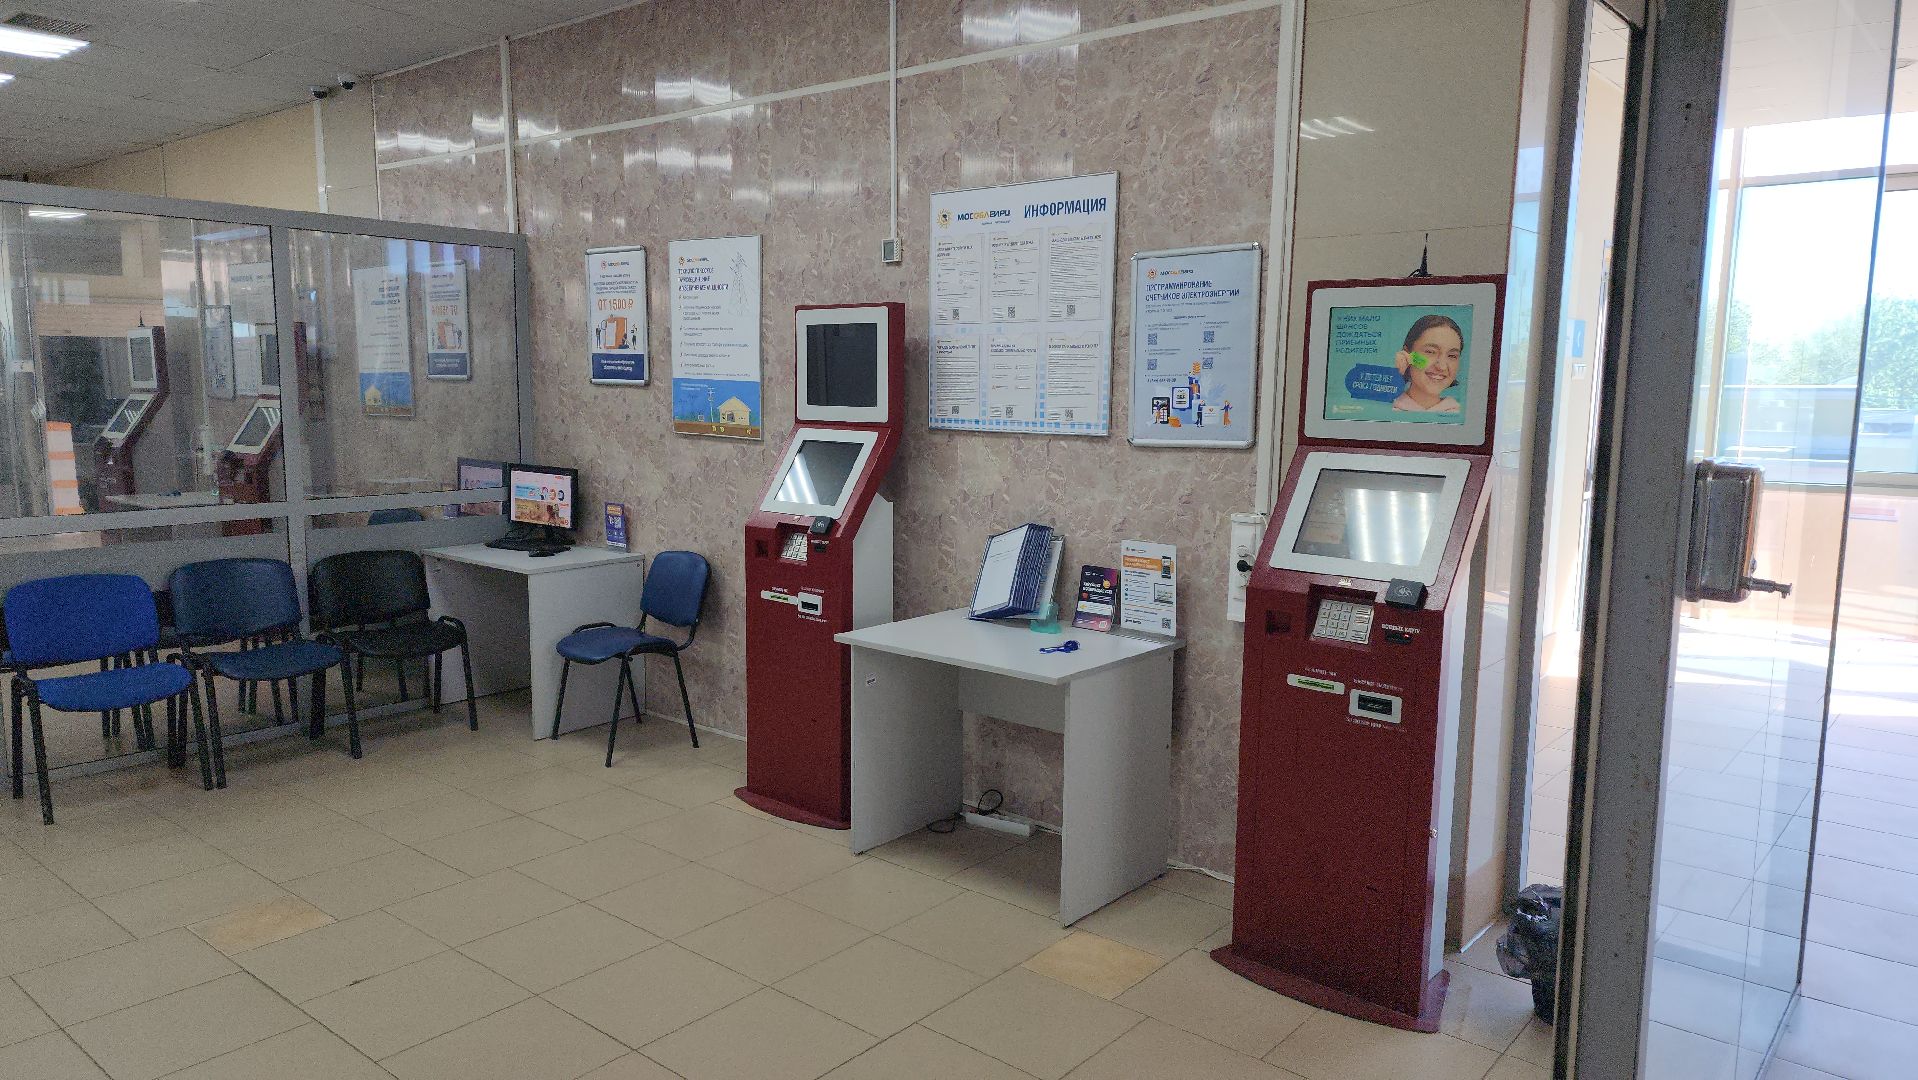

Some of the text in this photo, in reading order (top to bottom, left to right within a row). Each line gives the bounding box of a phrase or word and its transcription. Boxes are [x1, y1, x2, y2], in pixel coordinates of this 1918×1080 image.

[1024, 197, 1107, 219] ИНФОРМАЦИЯ
[1146, 280, 1213, 292] ПРОГРАММИРОВАНИЕ
[1145, 288, 1240, 302] СЧЕТЧИКОВ ЭЛЕКТРОЭНЕРГИИ
[598, 298, 607, 311] ОТ
[609, 298, 626, 311] 1500
